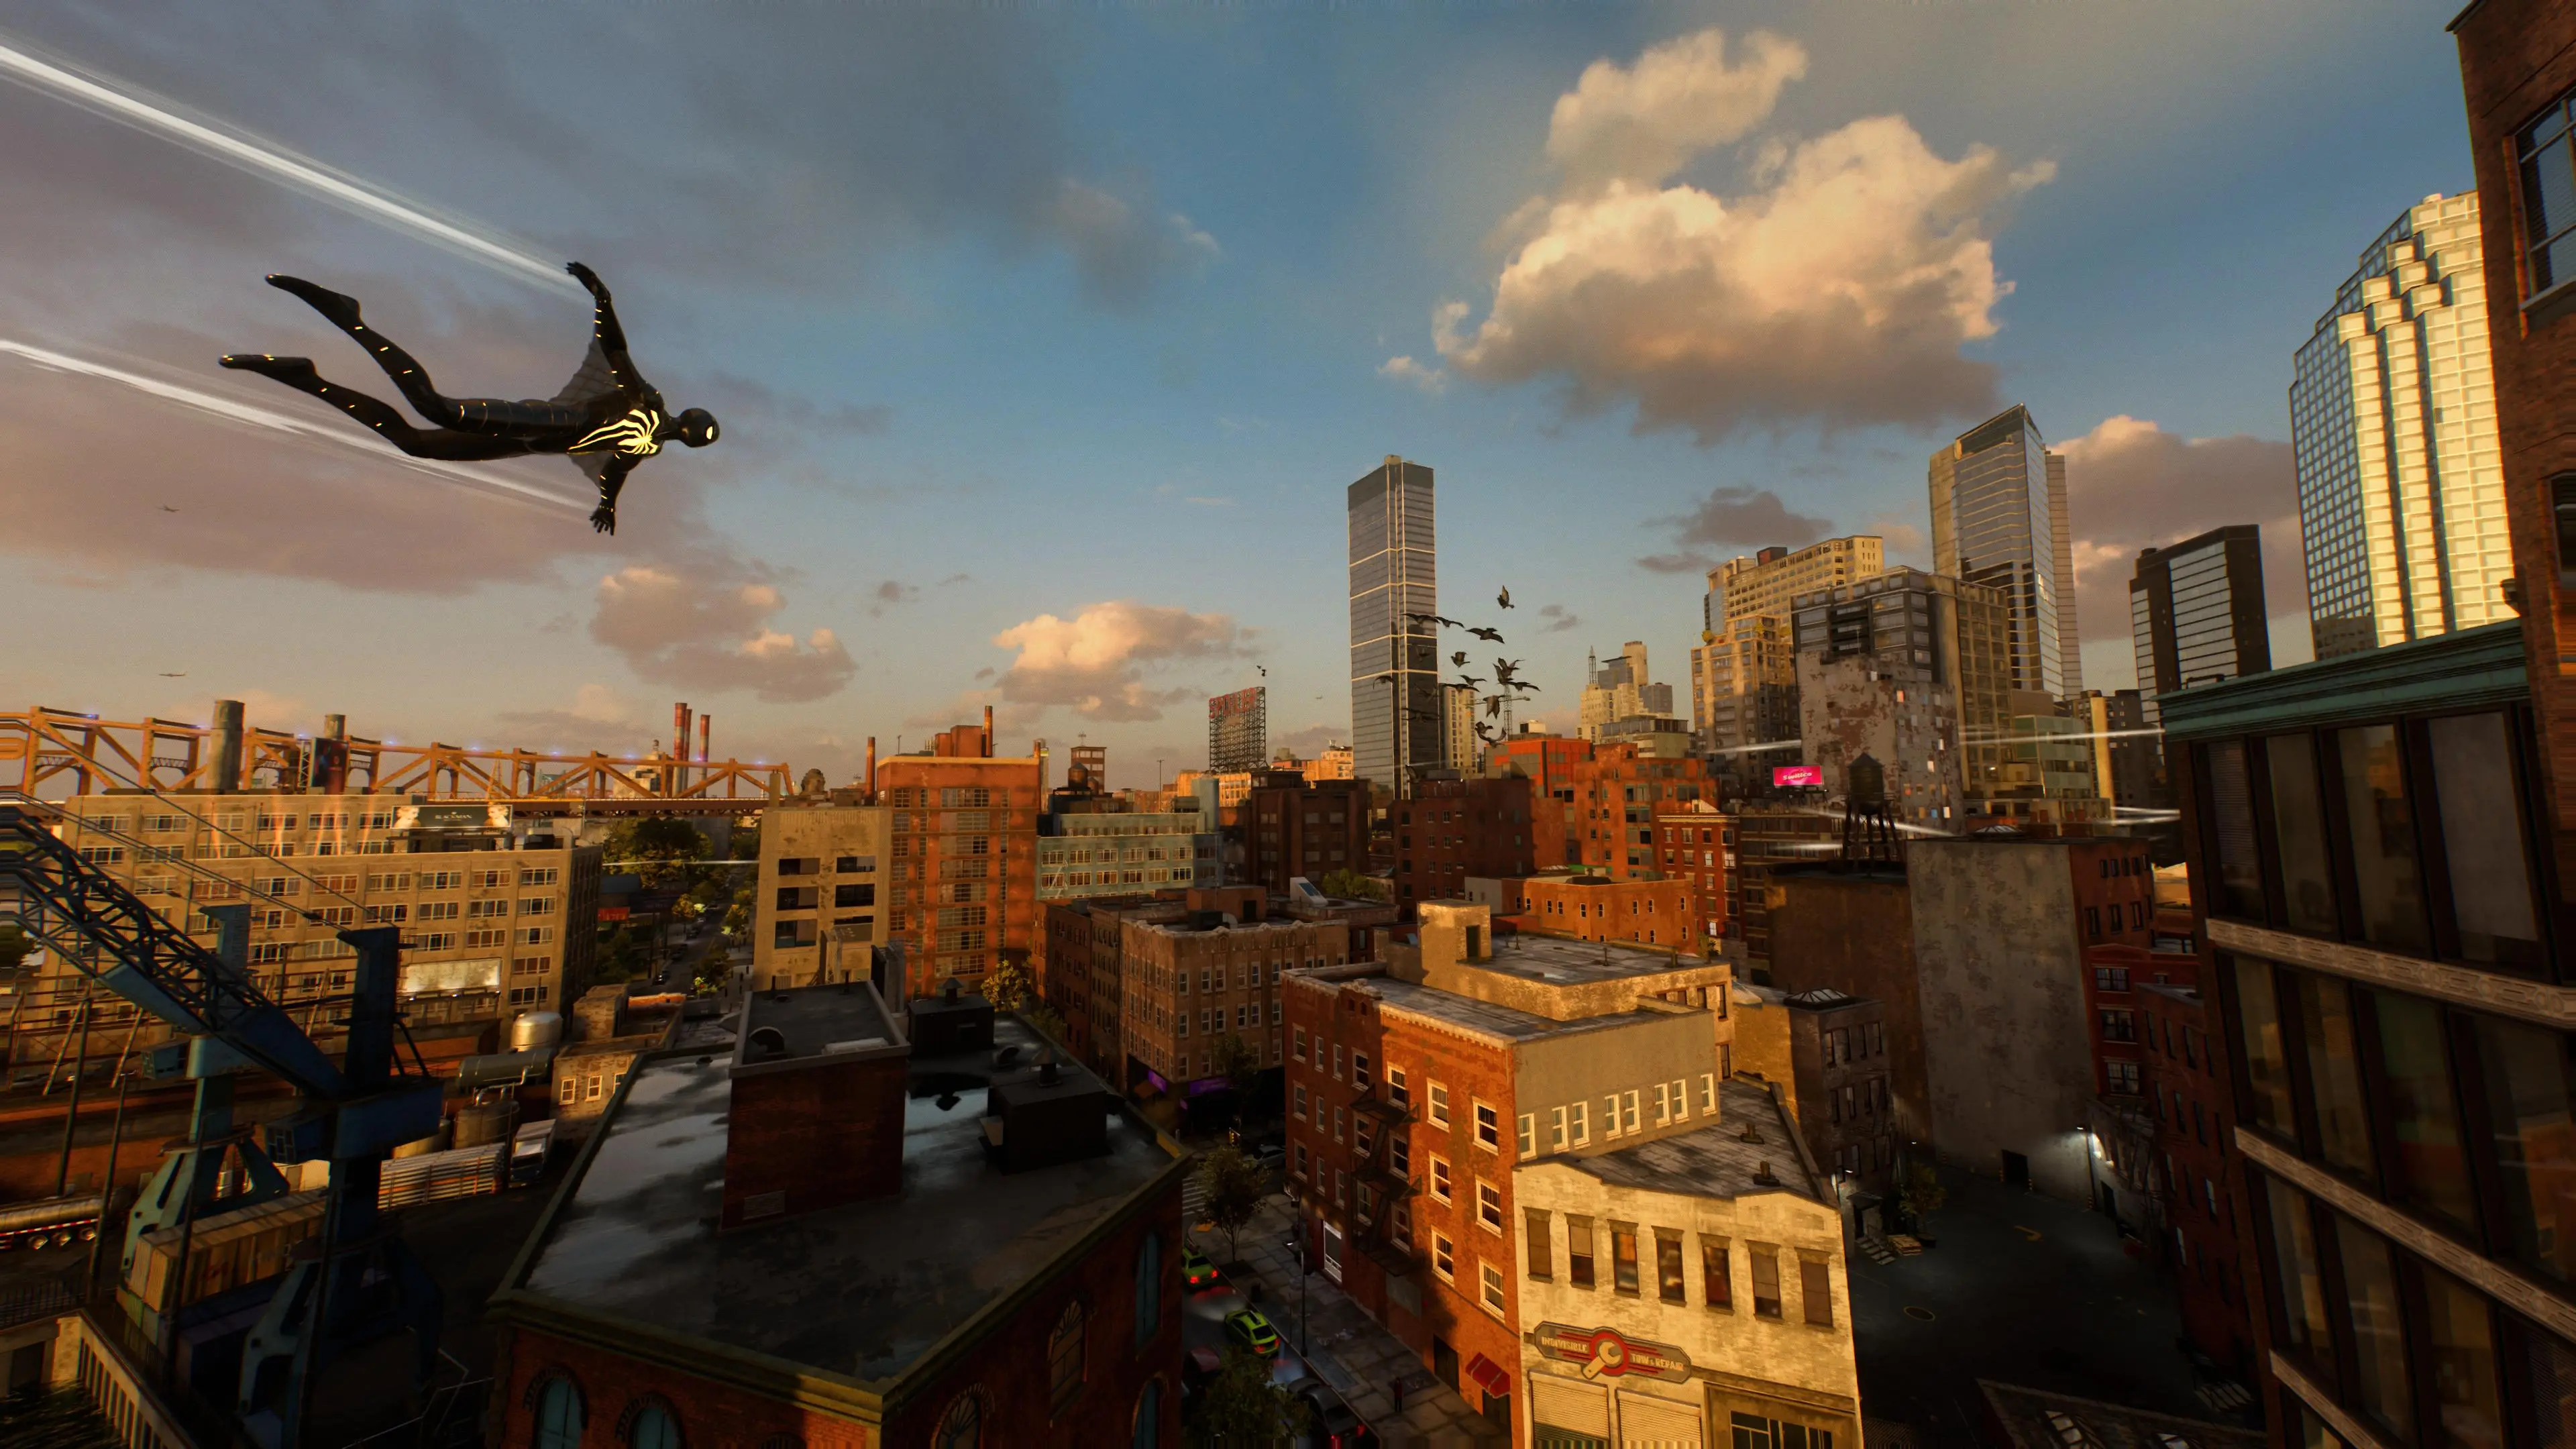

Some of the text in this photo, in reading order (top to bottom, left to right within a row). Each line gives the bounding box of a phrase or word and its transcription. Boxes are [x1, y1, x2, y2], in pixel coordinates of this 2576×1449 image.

[1542, 1336, 1587, 1353] INDIVISIBLE
[1631, 1354, 1650, 1364] TOW
[1655, 1359, 1684, 1371] REPAIR
